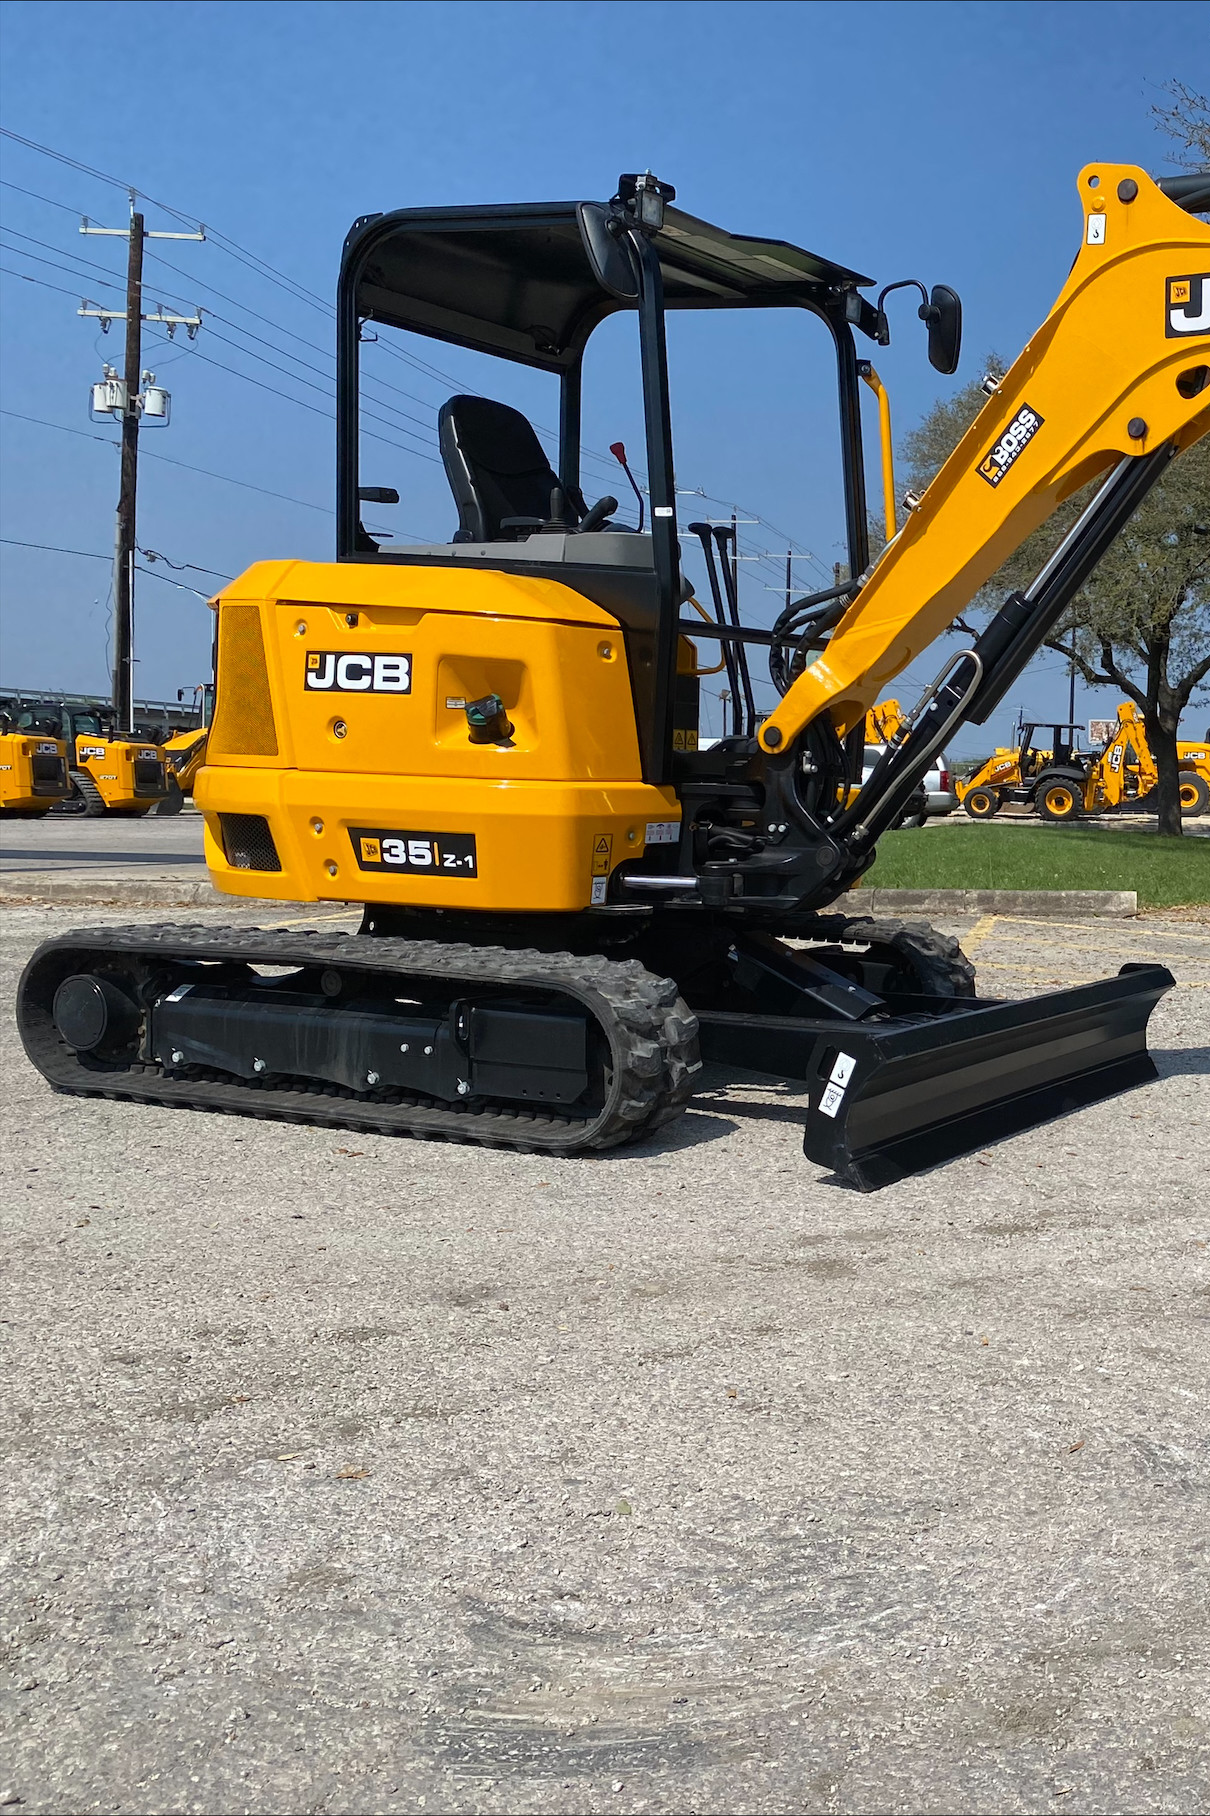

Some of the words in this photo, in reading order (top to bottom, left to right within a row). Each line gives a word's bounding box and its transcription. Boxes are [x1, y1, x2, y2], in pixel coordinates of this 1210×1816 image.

[991, 409, 1036, 466] BOSS
[307, 654, 410, 691] JCB
[36, 743, 58, 754] JCB
[80, 747, 105, 756] JCB
[138, 750, 157, 760] JCB
[994, 761, 1011, 772] JCB
[1110, 745, 1123, 773] JCB
[382, 839, 432, 865] 35
